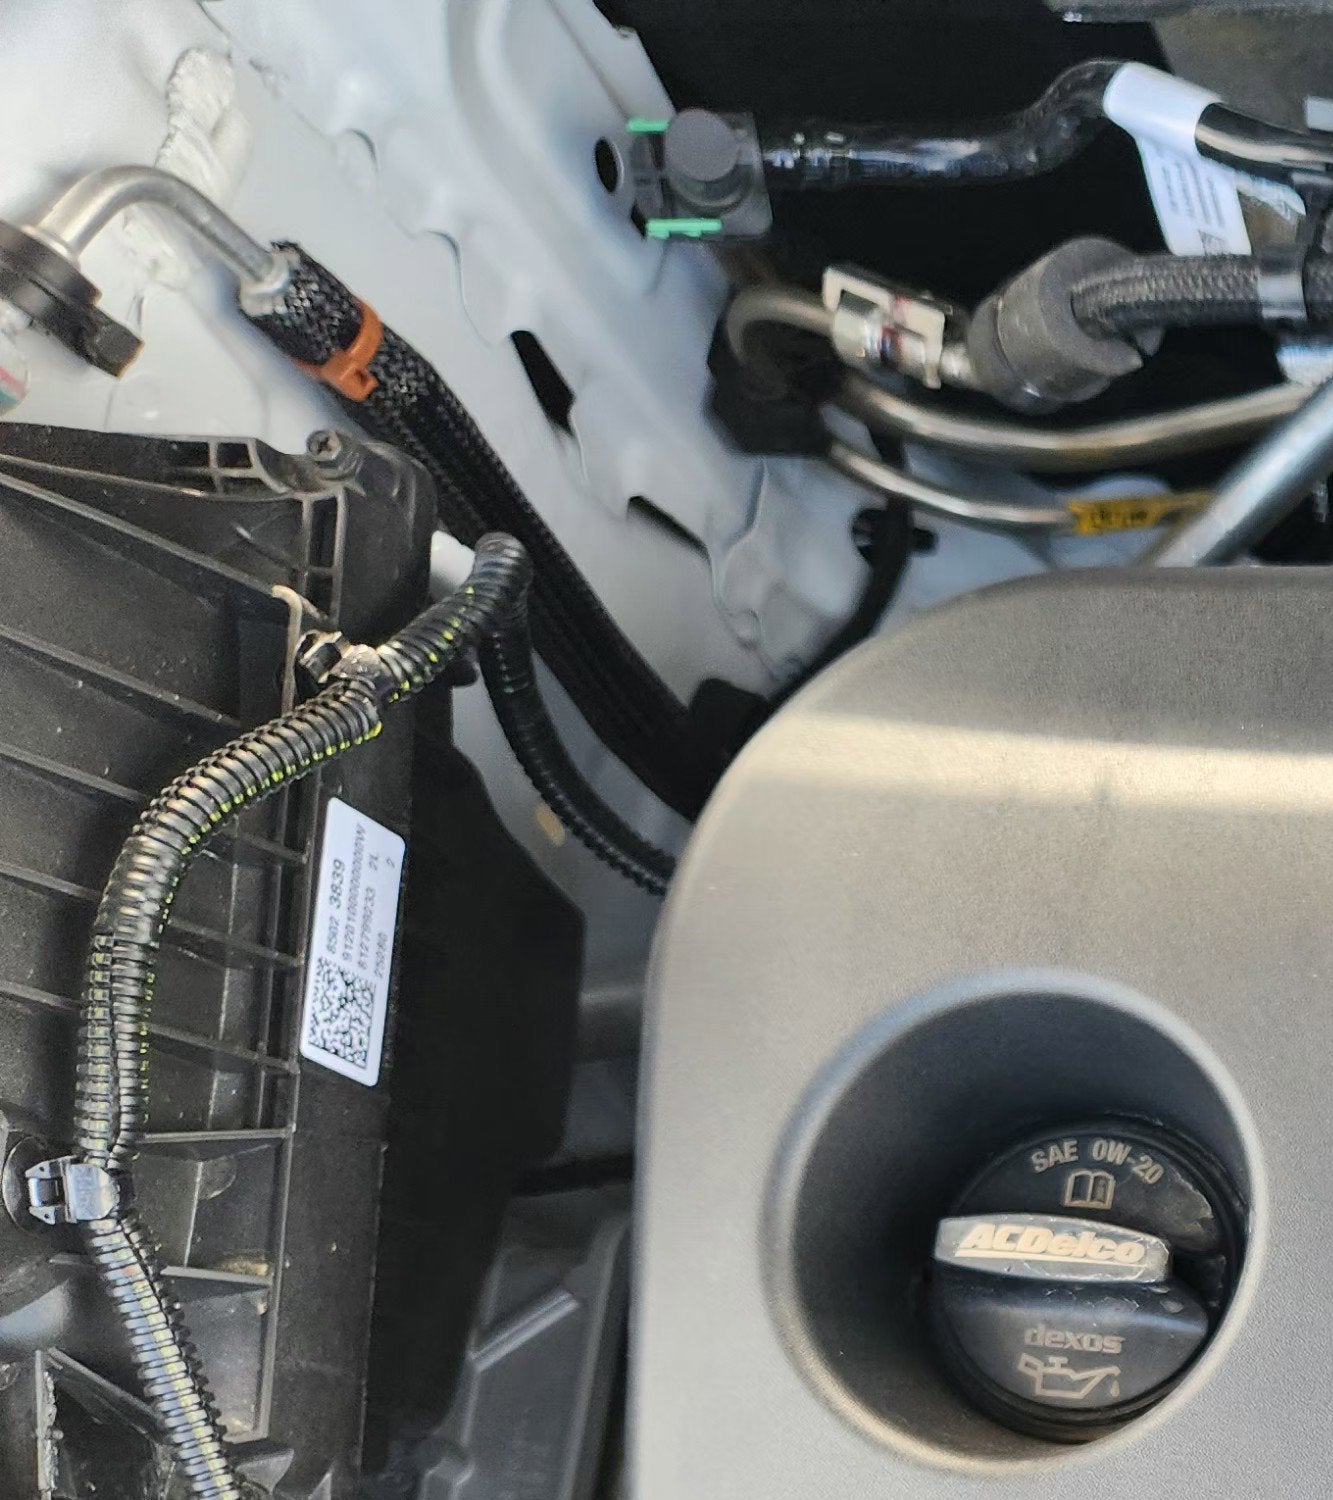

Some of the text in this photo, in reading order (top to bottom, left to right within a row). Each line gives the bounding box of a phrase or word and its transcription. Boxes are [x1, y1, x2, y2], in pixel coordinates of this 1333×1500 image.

[329, 859, 345, 909] 3839
[1030, 1138, 1164, 1185] SAE 0W-20
[956, 1223, 1146, 1264] ACDelco
[1024, 1326, 1125, 1354] dexos
